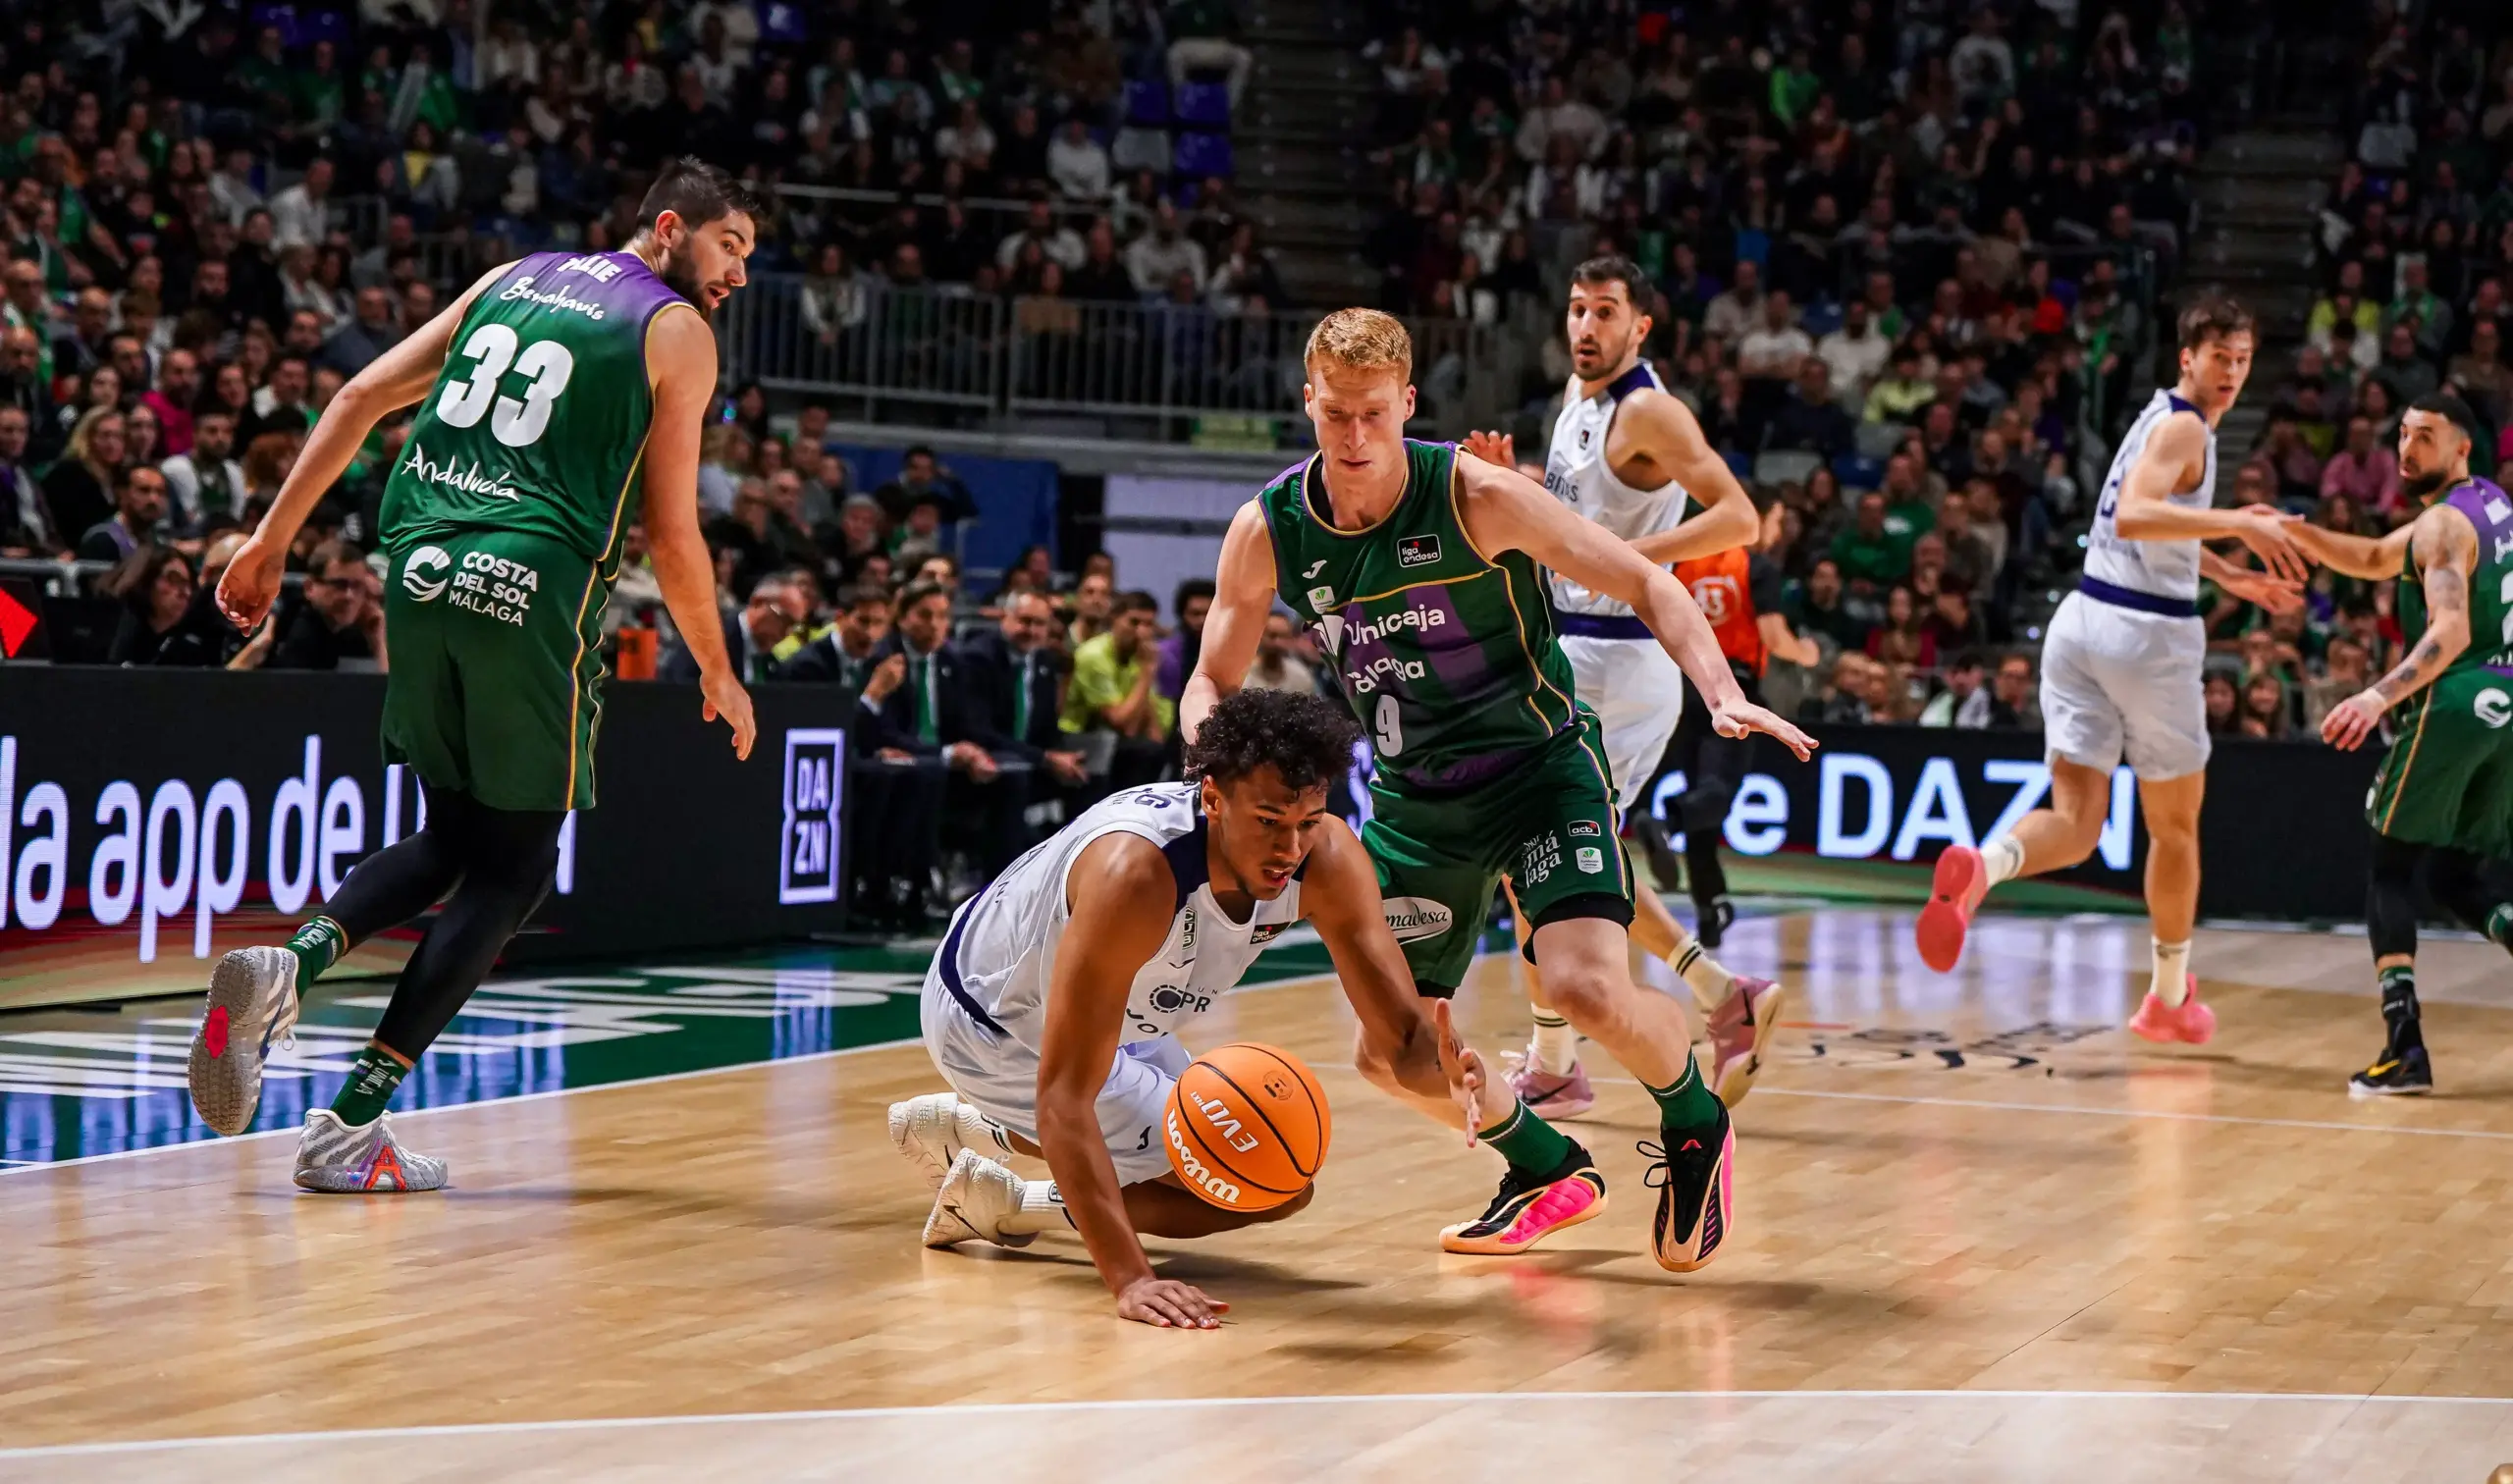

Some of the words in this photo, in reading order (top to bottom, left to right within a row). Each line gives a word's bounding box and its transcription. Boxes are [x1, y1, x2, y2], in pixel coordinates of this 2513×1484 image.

[436, 323, 573, 448] 33
[401, 443, 520, 502] Andalucía
[1402, 547, 1418, 556] liga
[1404, 552, 1438, 563] endesa
[453, 571, 488, 594] DEL
[491, 582, 530, 610] SOL
[462, 552, 538, 592] COSTA
[448, 590, 523, 626] MÁLAGA
[1345, 604, 1446, 646] Unicaja
[1347, 657, 1425, 695] álaga
[1375, 694, 1403, 757] 9
[0, 735, 69, 929] la
[89, 777, 251, 964] app
[268, 734, 365, 915] de
[1572, 824, 1593, 834] acb
[1167, 1107, 1241, 1204] Wilson
